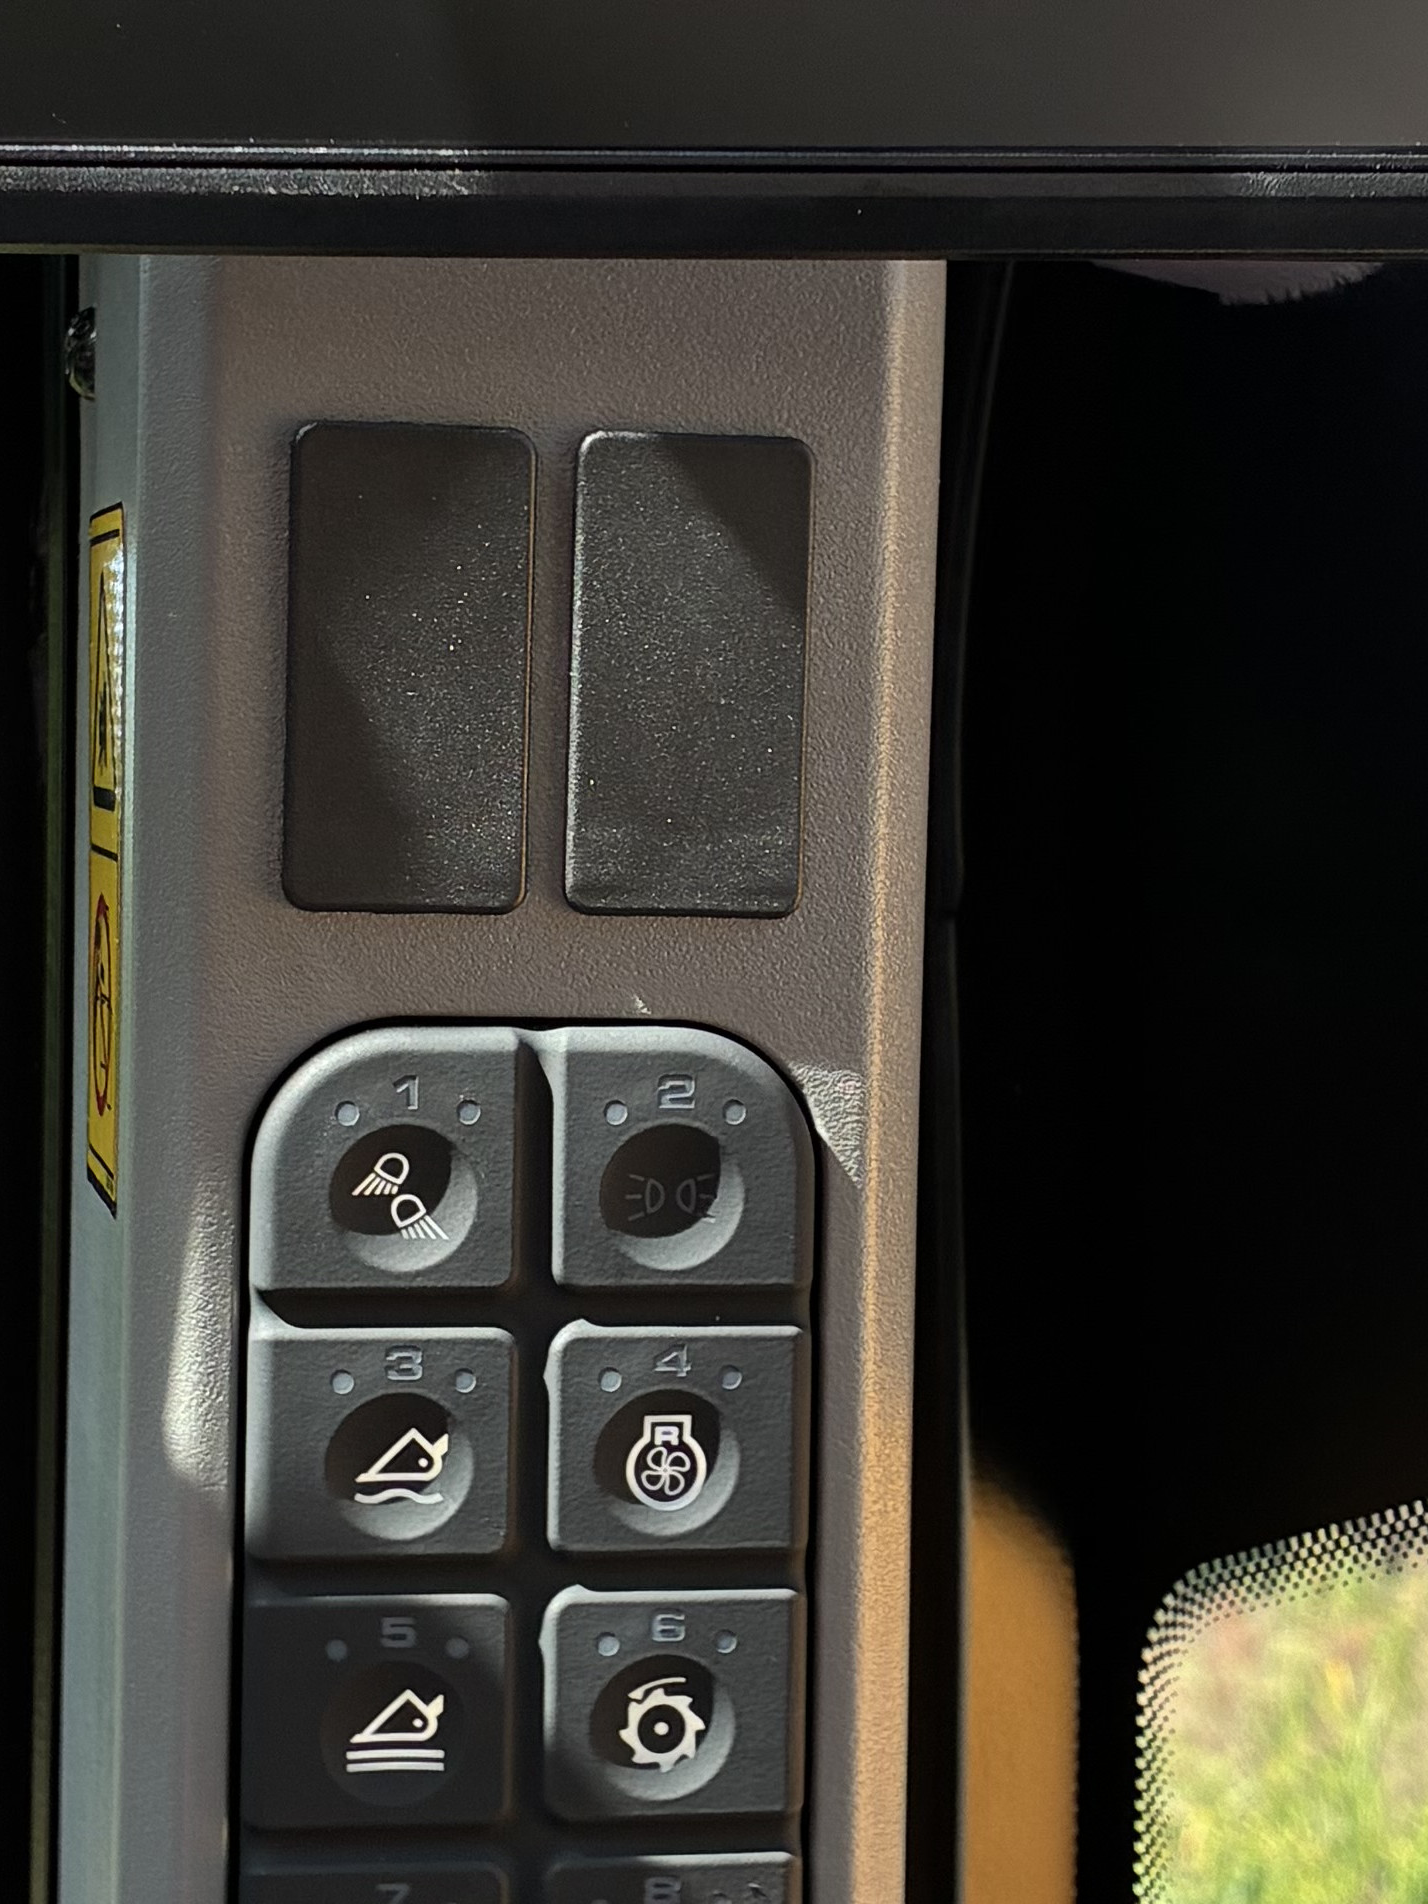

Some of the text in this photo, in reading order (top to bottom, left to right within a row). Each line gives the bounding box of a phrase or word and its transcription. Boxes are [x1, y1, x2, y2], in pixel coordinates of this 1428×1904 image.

[393, 1075, 420, 1109] 1
[658, 1074, 696, 1110] 2
[384, 1346, 423, 1381] 3
[652, 1345, 692, 1377] 4
[380, 1616, 417, 1648] 5
[650, 1613, 686, 1643] 6
